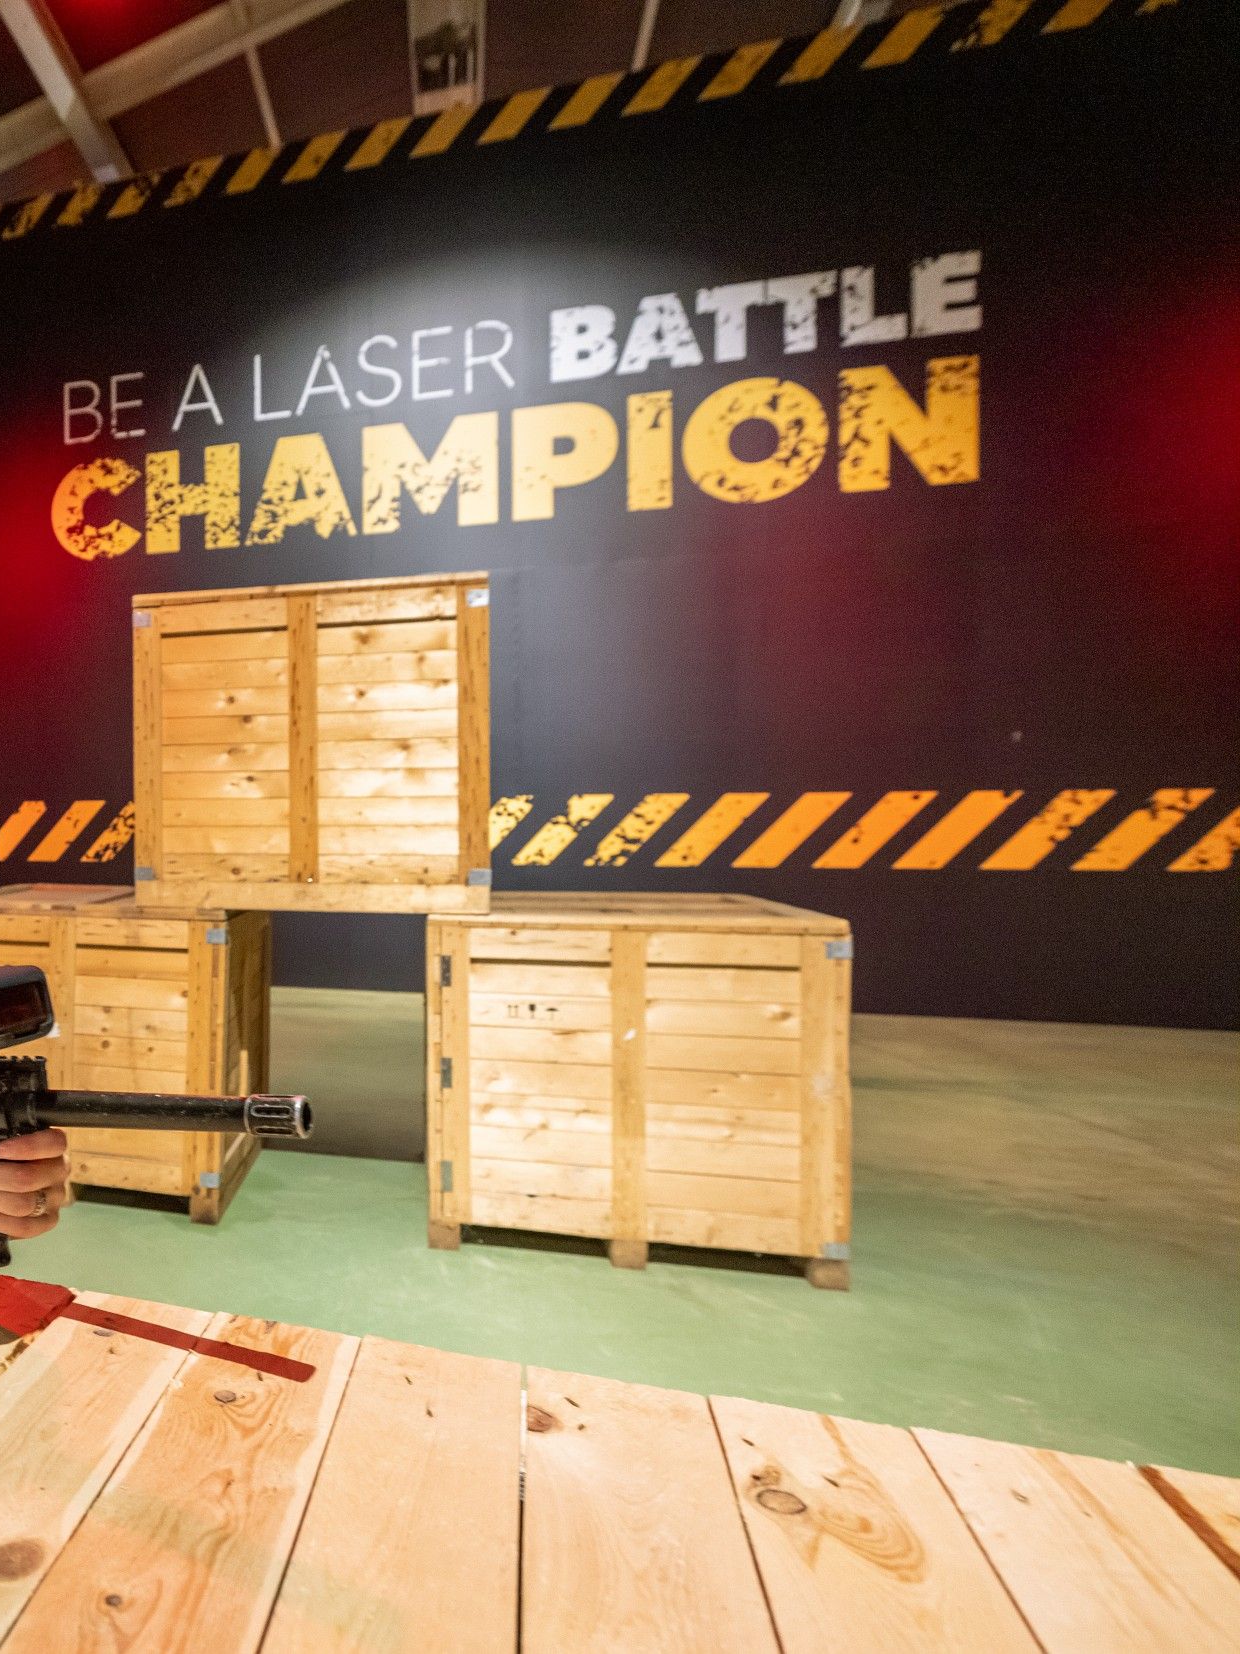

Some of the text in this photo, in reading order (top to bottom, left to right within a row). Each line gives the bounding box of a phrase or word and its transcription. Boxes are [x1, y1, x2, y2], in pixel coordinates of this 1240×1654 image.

[62, 250, 984, 446] BE A LASER BATTLE
[50, 354, 981, 562] CHAMPION
